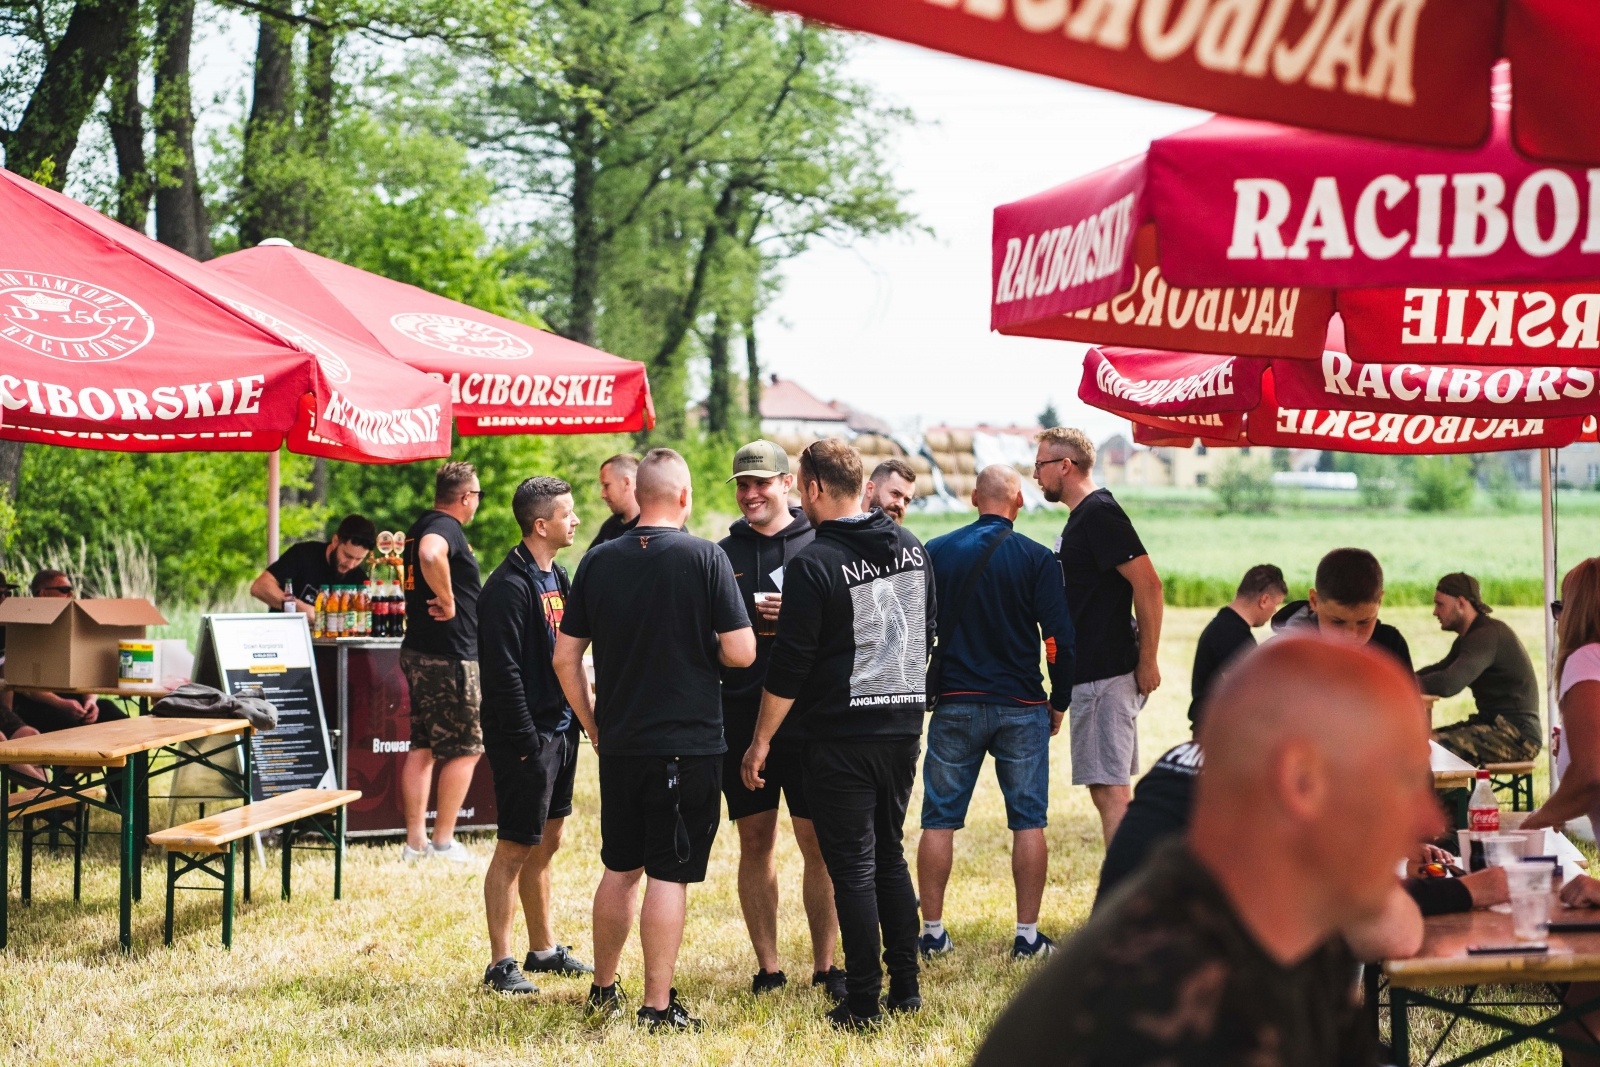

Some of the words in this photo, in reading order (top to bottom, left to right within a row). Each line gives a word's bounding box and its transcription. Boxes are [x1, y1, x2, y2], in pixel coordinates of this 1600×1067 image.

[58, 308, 136, 331] 1567
[1321, 349, 1600, 404] RACIBORS
[426, 372, 616, 406] ACIBORSKIE
[850, 695, 891, 707] ANGLING
[372, 737, 412, 754] Browar
